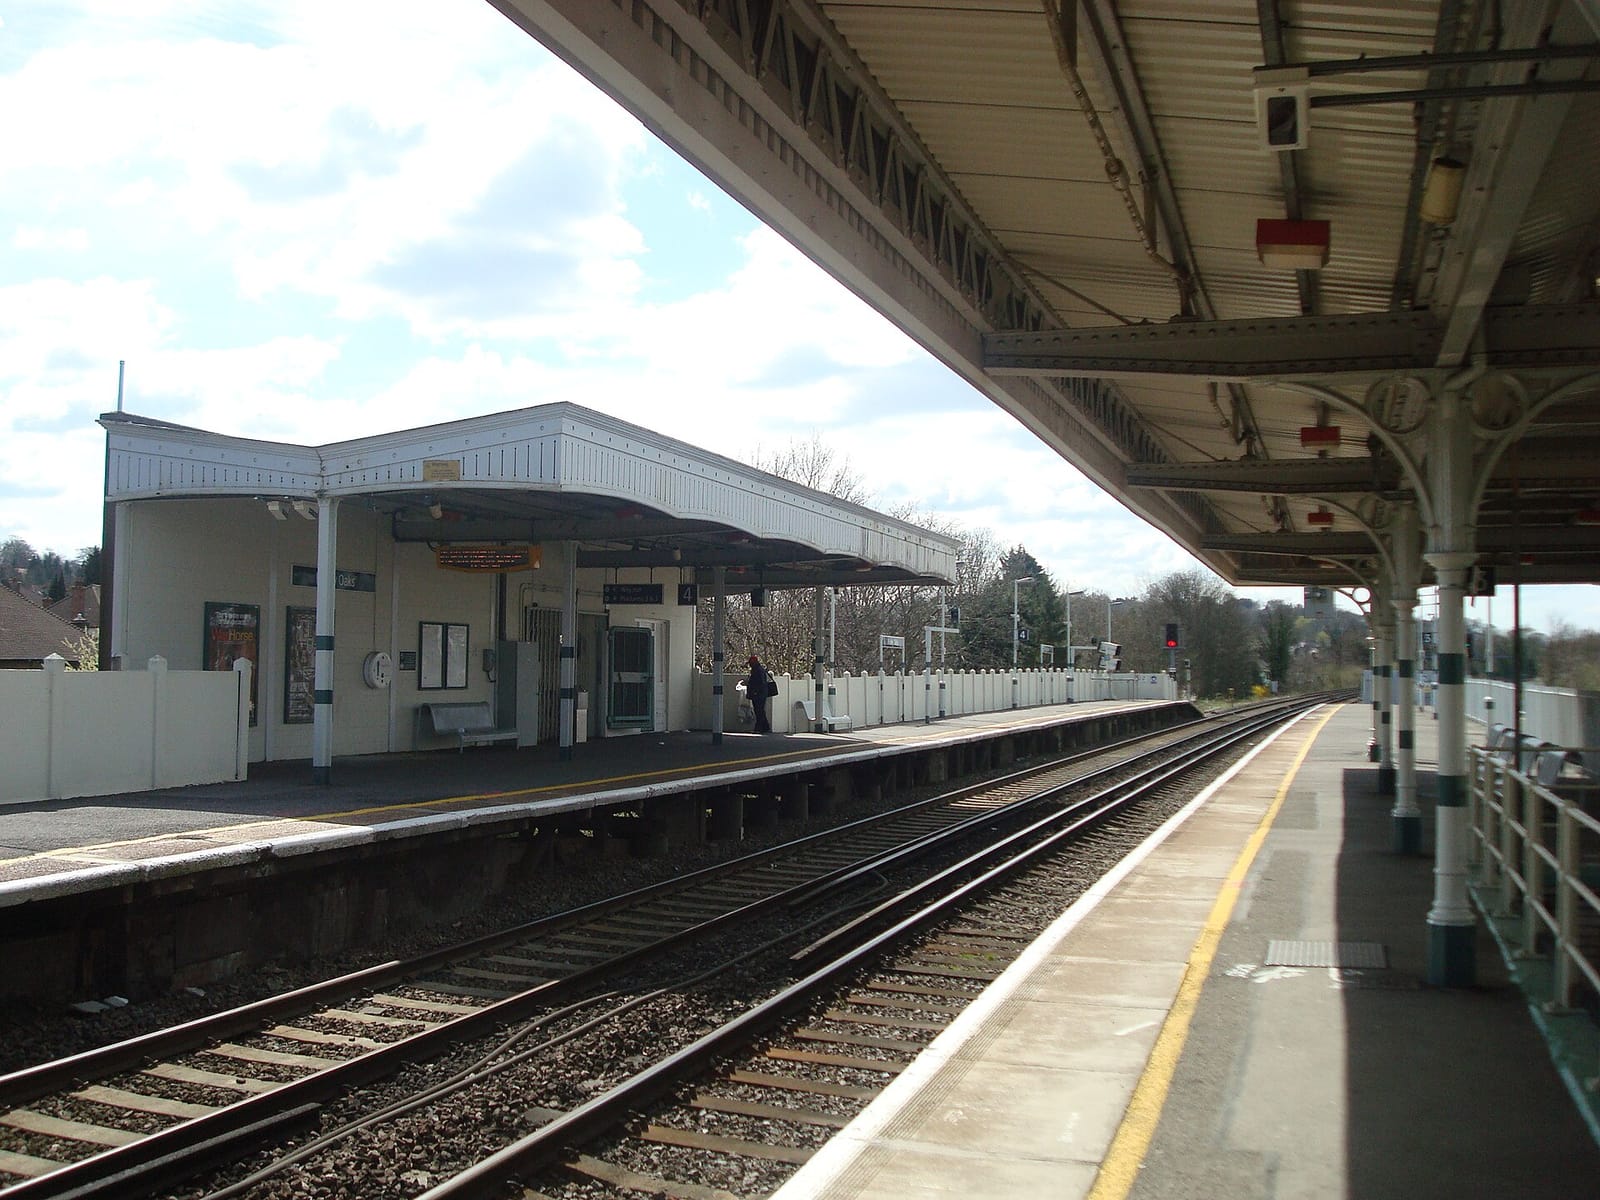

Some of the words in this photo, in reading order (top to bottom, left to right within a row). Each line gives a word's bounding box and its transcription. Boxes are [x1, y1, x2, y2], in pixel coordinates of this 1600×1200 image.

[338, 574, 356, 588] Oaks
[684, 586, 693, 602] 4
[1020, 631, 1027, 639] 4
[1424, 634, 1432, 643] 5
